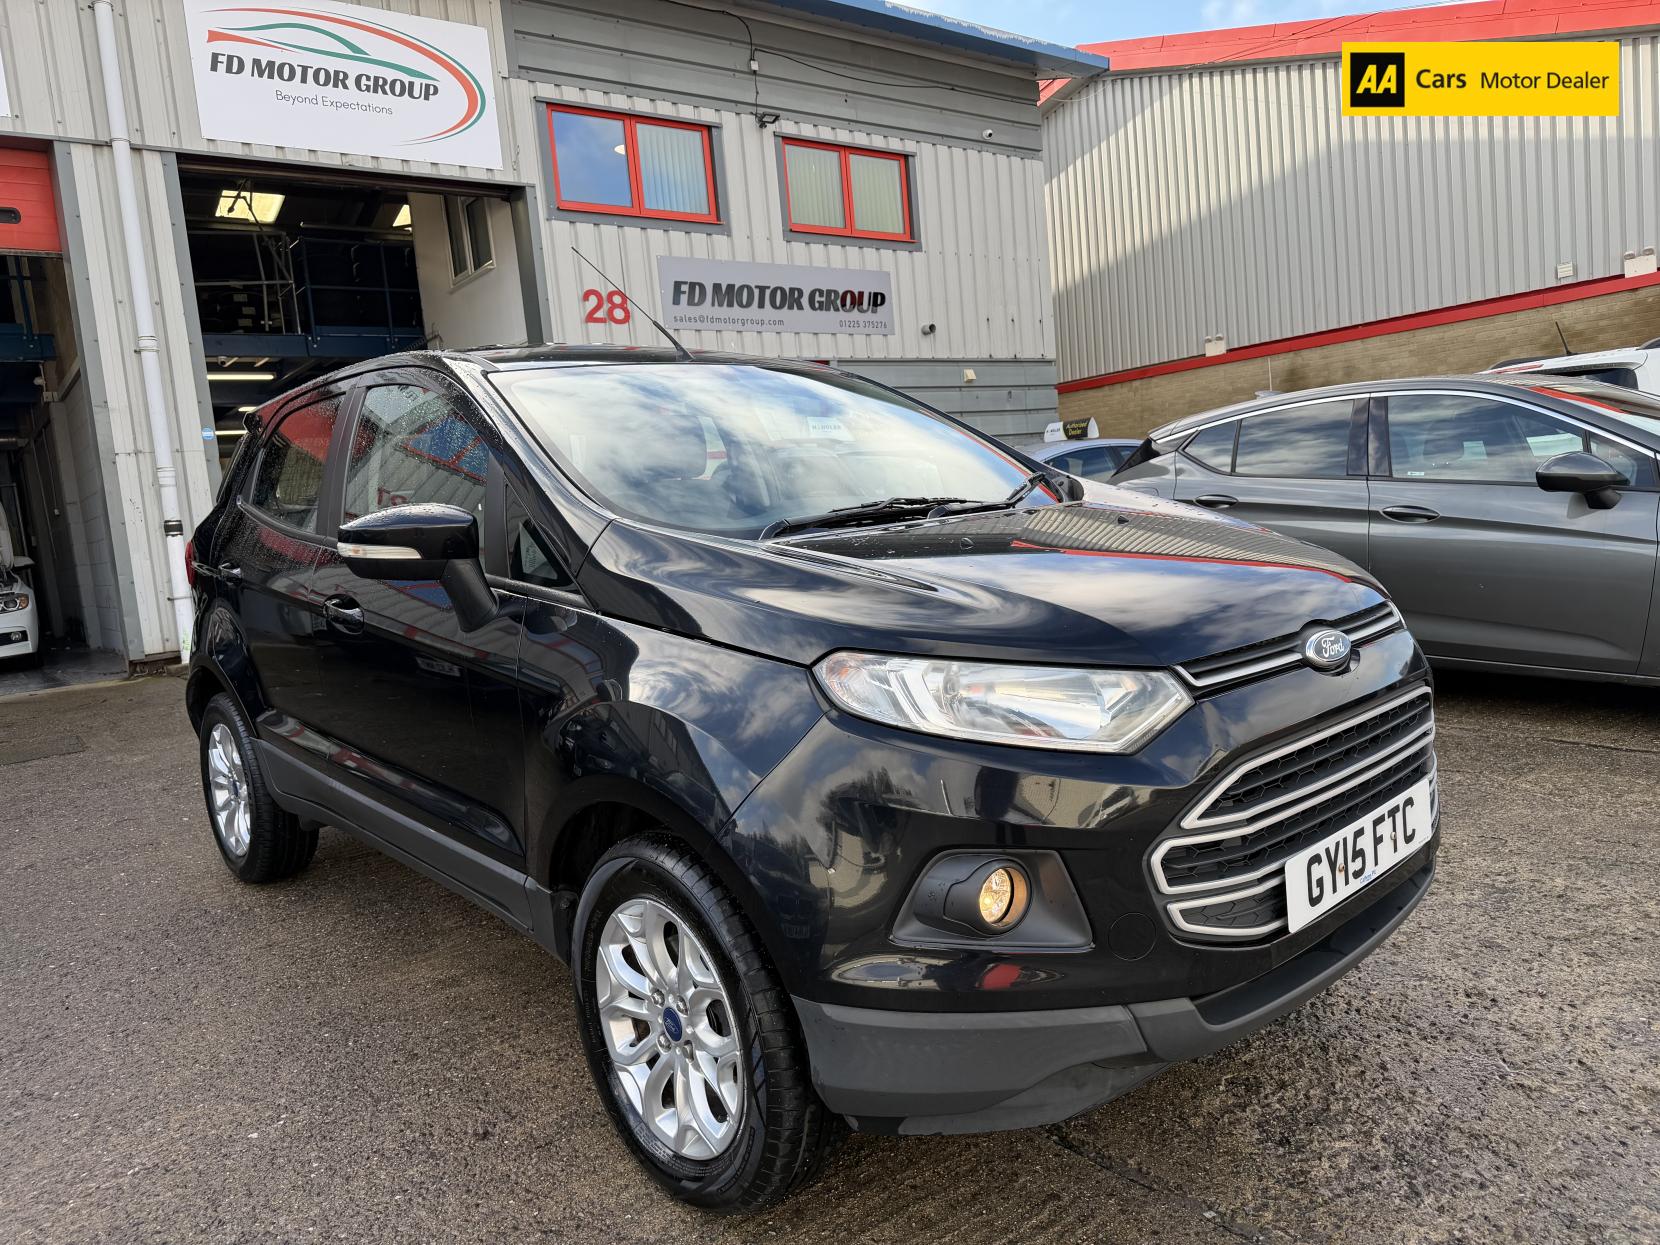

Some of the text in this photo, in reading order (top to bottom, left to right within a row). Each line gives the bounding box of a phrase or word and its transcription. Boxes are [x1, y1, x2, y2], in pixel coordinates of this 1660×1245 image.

[210, 52, 439, 102] FD MOTOR GROUP
[275, 90, 393, 115] Beyond Expectations
[582, 288, 631, 325] 28
[672, 281, 886, 314] FD MOTOR GROUP
[673, 314, 785, 327] sales@fdmotorgroup.com
[839, 319, 860, 328] 01225
[1321, 636, 1344, 658] Ford
[1307, 796, 1416, 908] GY15 FTC
